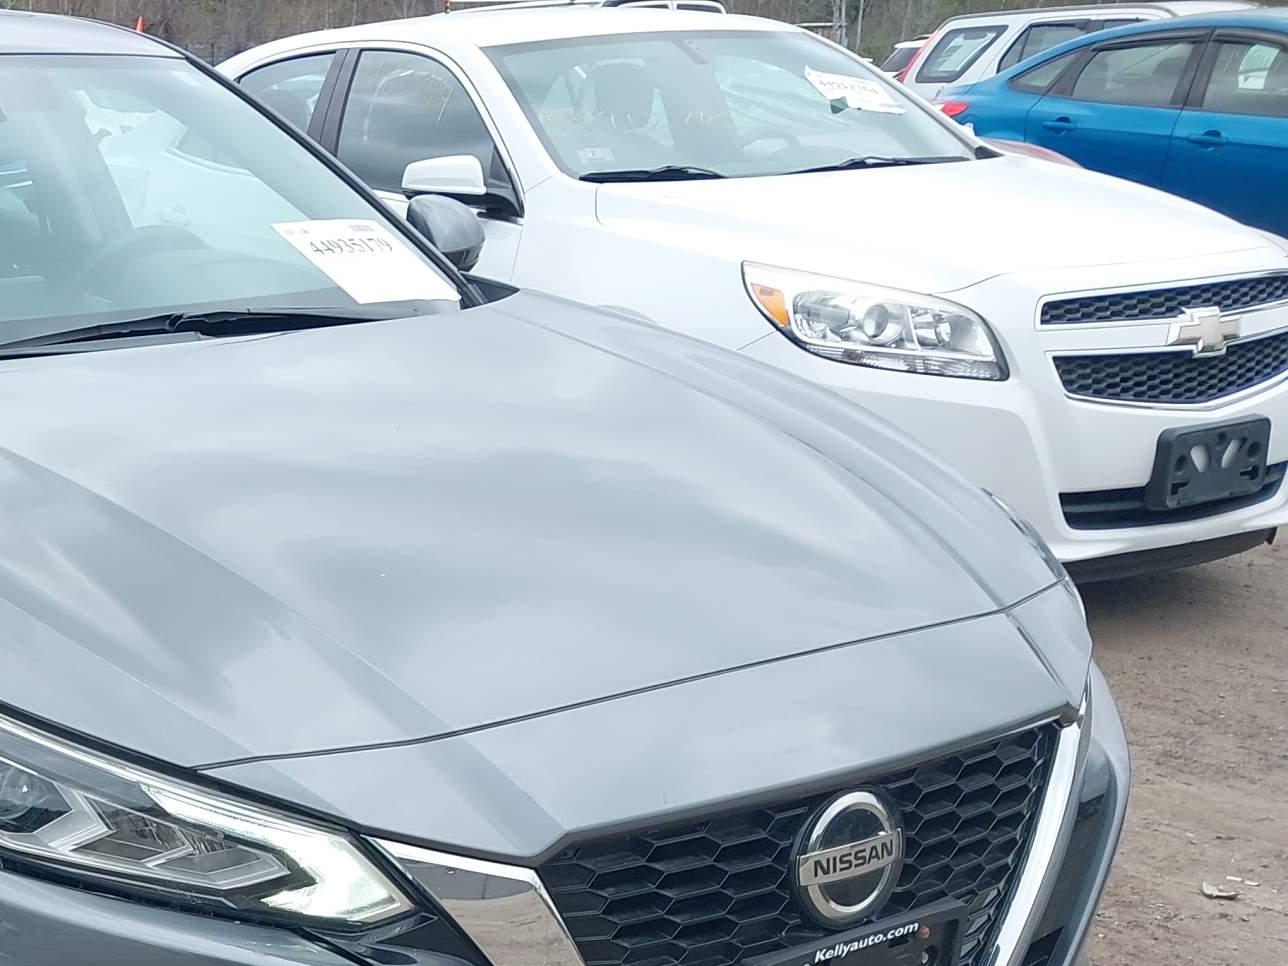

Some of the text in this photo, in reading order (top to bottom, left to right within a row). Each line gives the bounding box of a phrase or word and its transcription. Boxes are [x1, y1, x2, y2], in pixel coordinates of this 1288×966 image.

[309, 238, 393, 255] 44935179
[814, 839, 893, 878] NISSAN
[814, 922, 919, 963] Kellyauto.com
